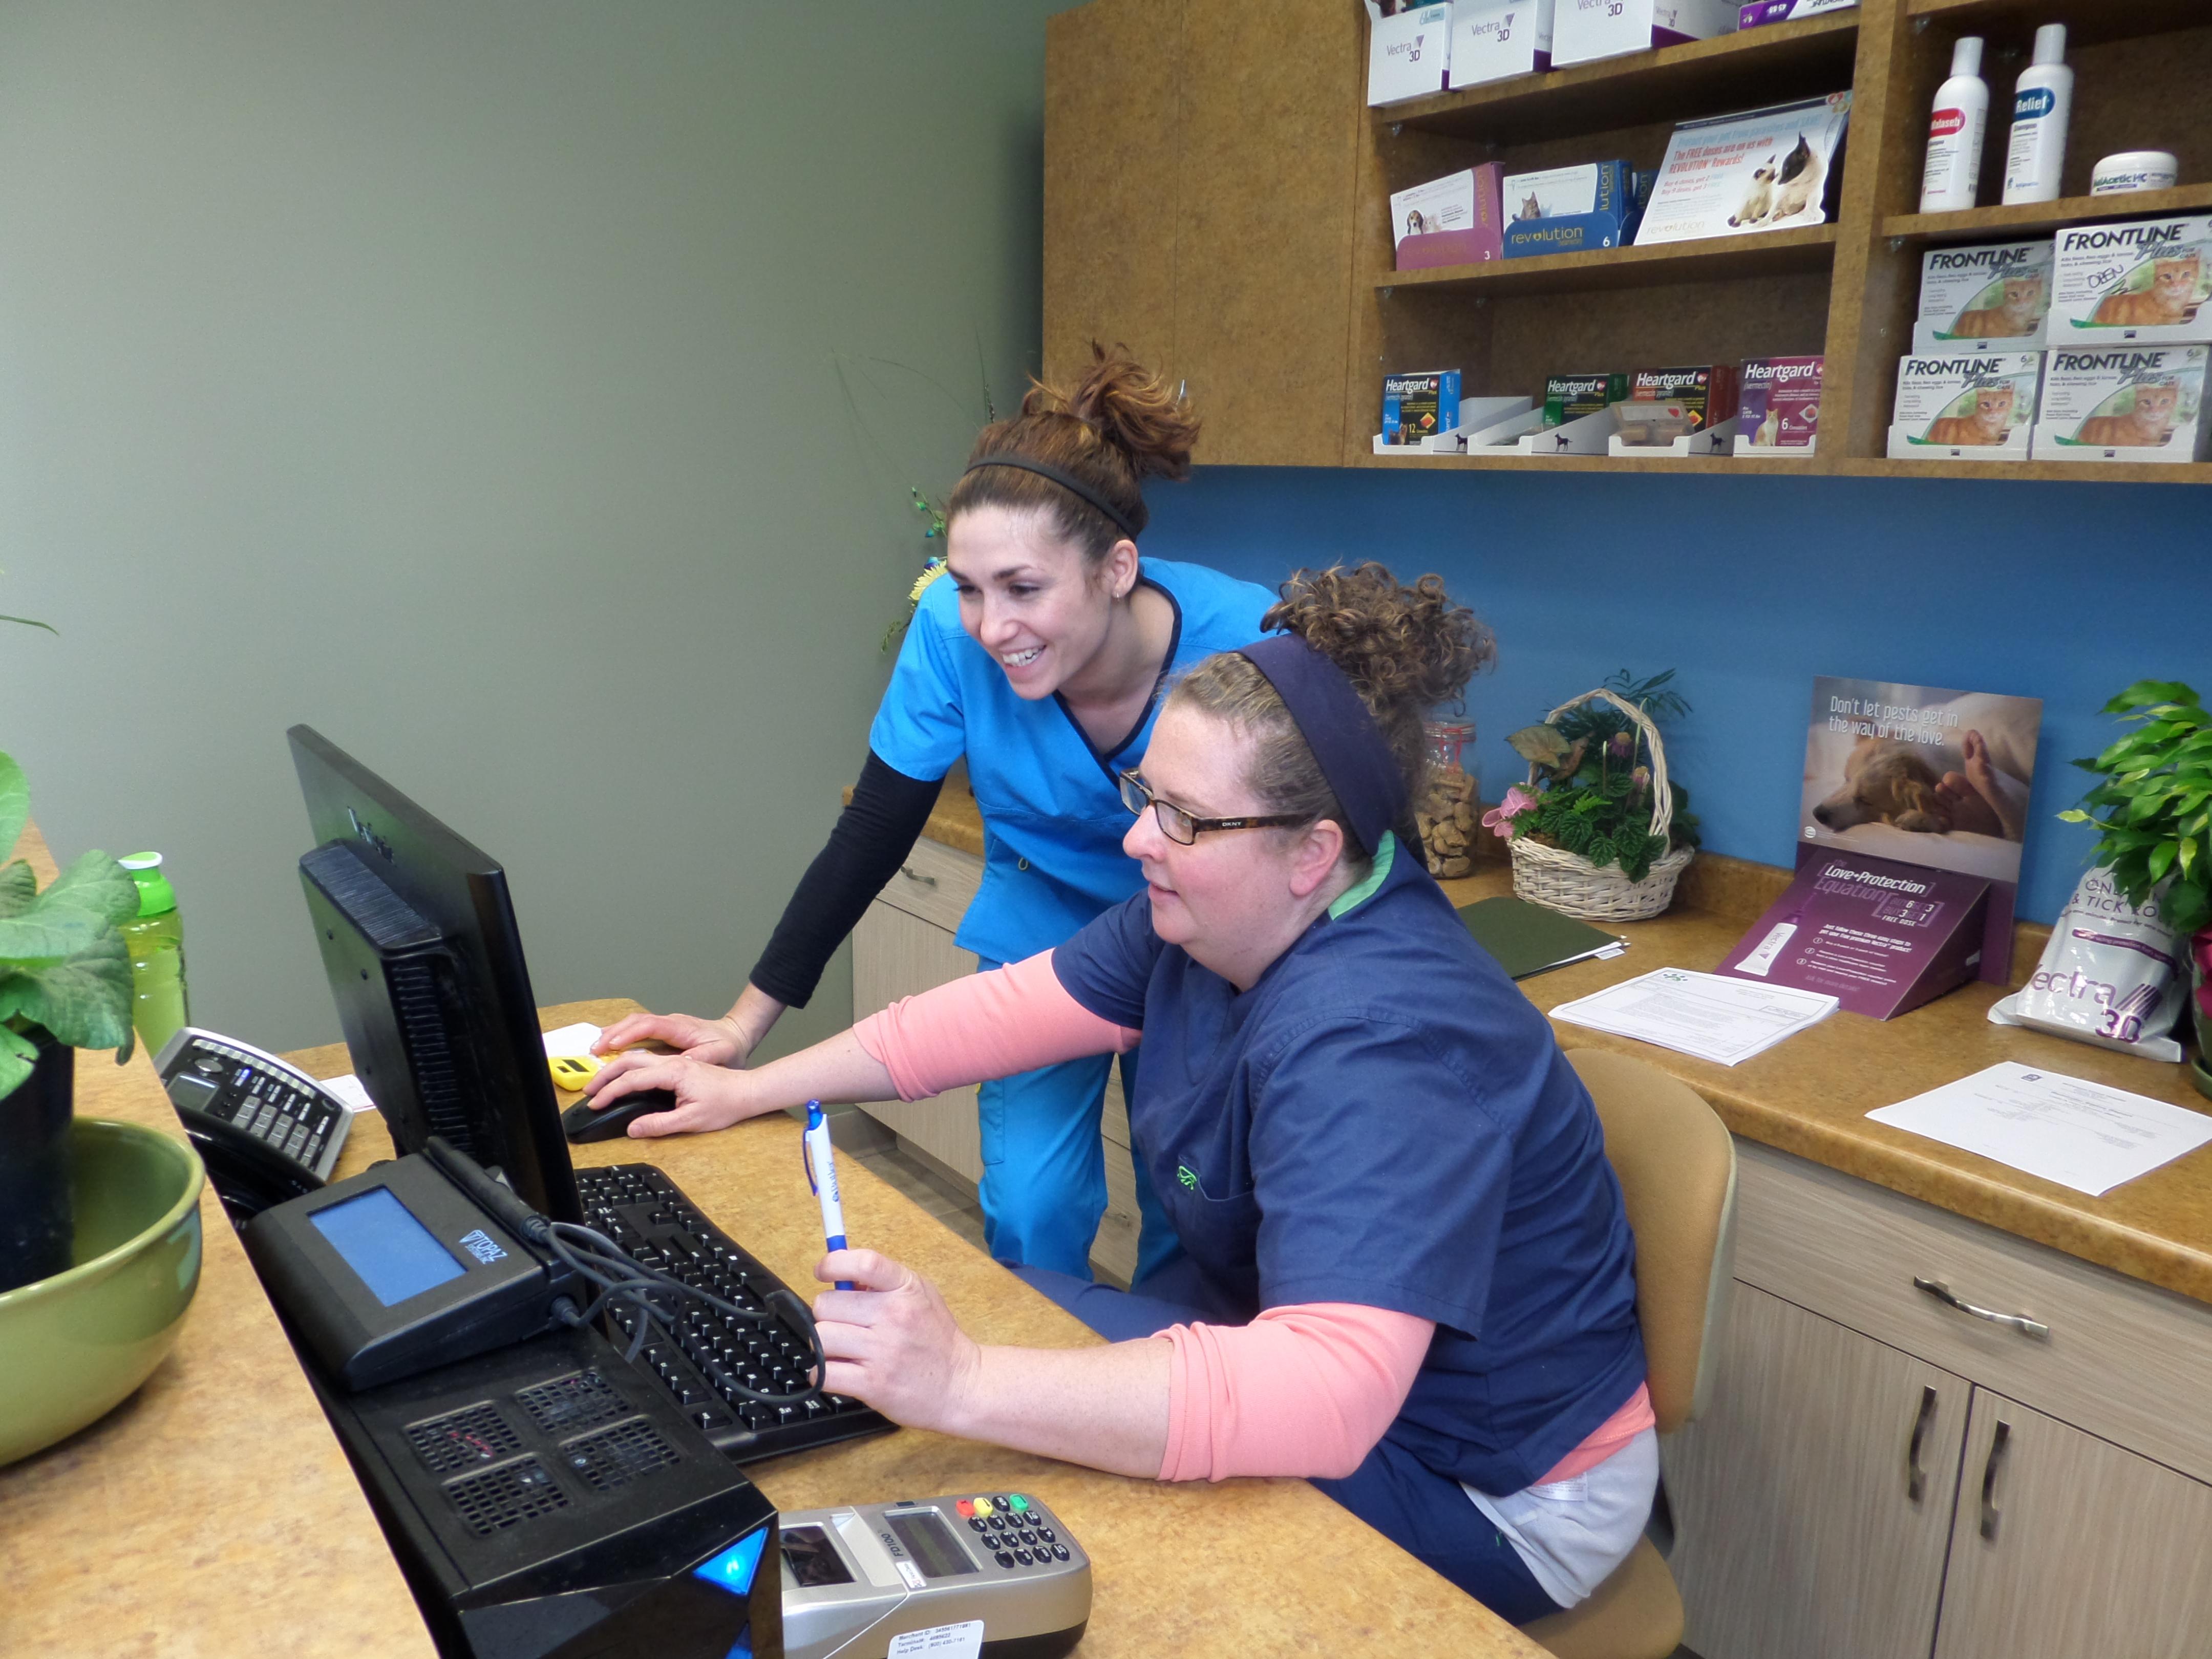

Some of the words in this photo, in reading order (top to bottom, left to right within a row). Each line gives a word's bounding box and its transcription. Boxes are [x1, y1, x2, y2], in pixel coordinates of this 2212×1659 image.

[1608, 3, 1623, 17] 3D
[1472, 22, 1500, 36] Vectra
[1497, 28, 1510, 42] 3D
[1387, 42, 1412, 56] Vectra
[1409, 50, 1420, 62] 3D
[2016, 95, 2047, 113] Relief
[1673, 150, 1685, 161] The
[1685, 147, 1701, 158] FREE
[1703, 143, 1723, 156] doses
[1724, 142, 1736, 154] are
[1756, 137, 1774, 148] with
[1711, 154, 1745, 167] Rewards!
[1512, 227, 1583, 244] revolution
[1646, 221, 1705, 234] revolution
[1603, 236, 1610, 247] 6
[2064, 223, 2185, 251] FRONTLINE
[1484, 251, 1491, 260] 3
[1929, 247, 2031, 270] FRONTLINE
[2134, 240, 2184, 261] Plus
[1987, 262, 2029, 280] Plus
[2087, 264, 2124, 288] OPEN
[2053, 352, 2166, 371] FRONTLINE
[2186, 349, 2194, 357] 6
[1745, 361, 1816, 382] Heartgard
[1905, 358, 2003, 375] FRONTLINE
[1636, 371, 1696, 390] Heartgard
[1961, 372, 2001, 389] Plus
[2117, 367, 2164, 385] Plus
[1386, 378, 1430, 394] Heartgard
[1547, 379, 1597, 395] Heartgard
[1409, 423, 1416, 434] 12
[1781, 417, 1789, 430] 6
[1831, 695, 1860, 715] Don't
[1863, 699, 1880, 718] let
[1883, 704, 1918, 722] pests
[1922, 708, 1943, 727] get
[1946, 708, 1959, 728] in
[1829, 715, 1848, 733] the
[1852, 721, 1874, 739] way
[1878, 721, 1890, 738] of
[1895, 725, 1915, 742] the
[1918, 728, 1945, 746] love.
[1824, 865, 1926, 895] Love+Protection
[1813, 876, 1888, 903] Equation
[1906, 900, 1916, 909] 6
[1925, 904, 1935, 912] 3
[2072, 894, 2079, 904] &
[2087, 896, 2124, 913] TICK
[1882, 914, 1899, 923] FREE
[1899, 909, 1908, 918] 3
[1919, 913, 1927, 922] 1
[1764, 930, 1785, 952] Vectra
[2031, 964, 2117, 1006] ectra
[2095, 1008, 2142, 1044] 3D
[473, 1235, 508, 1262] TOPAZ
[881, 1533, 904, 1557] FD100
[899, 1632, 923, 1640] Merchant
